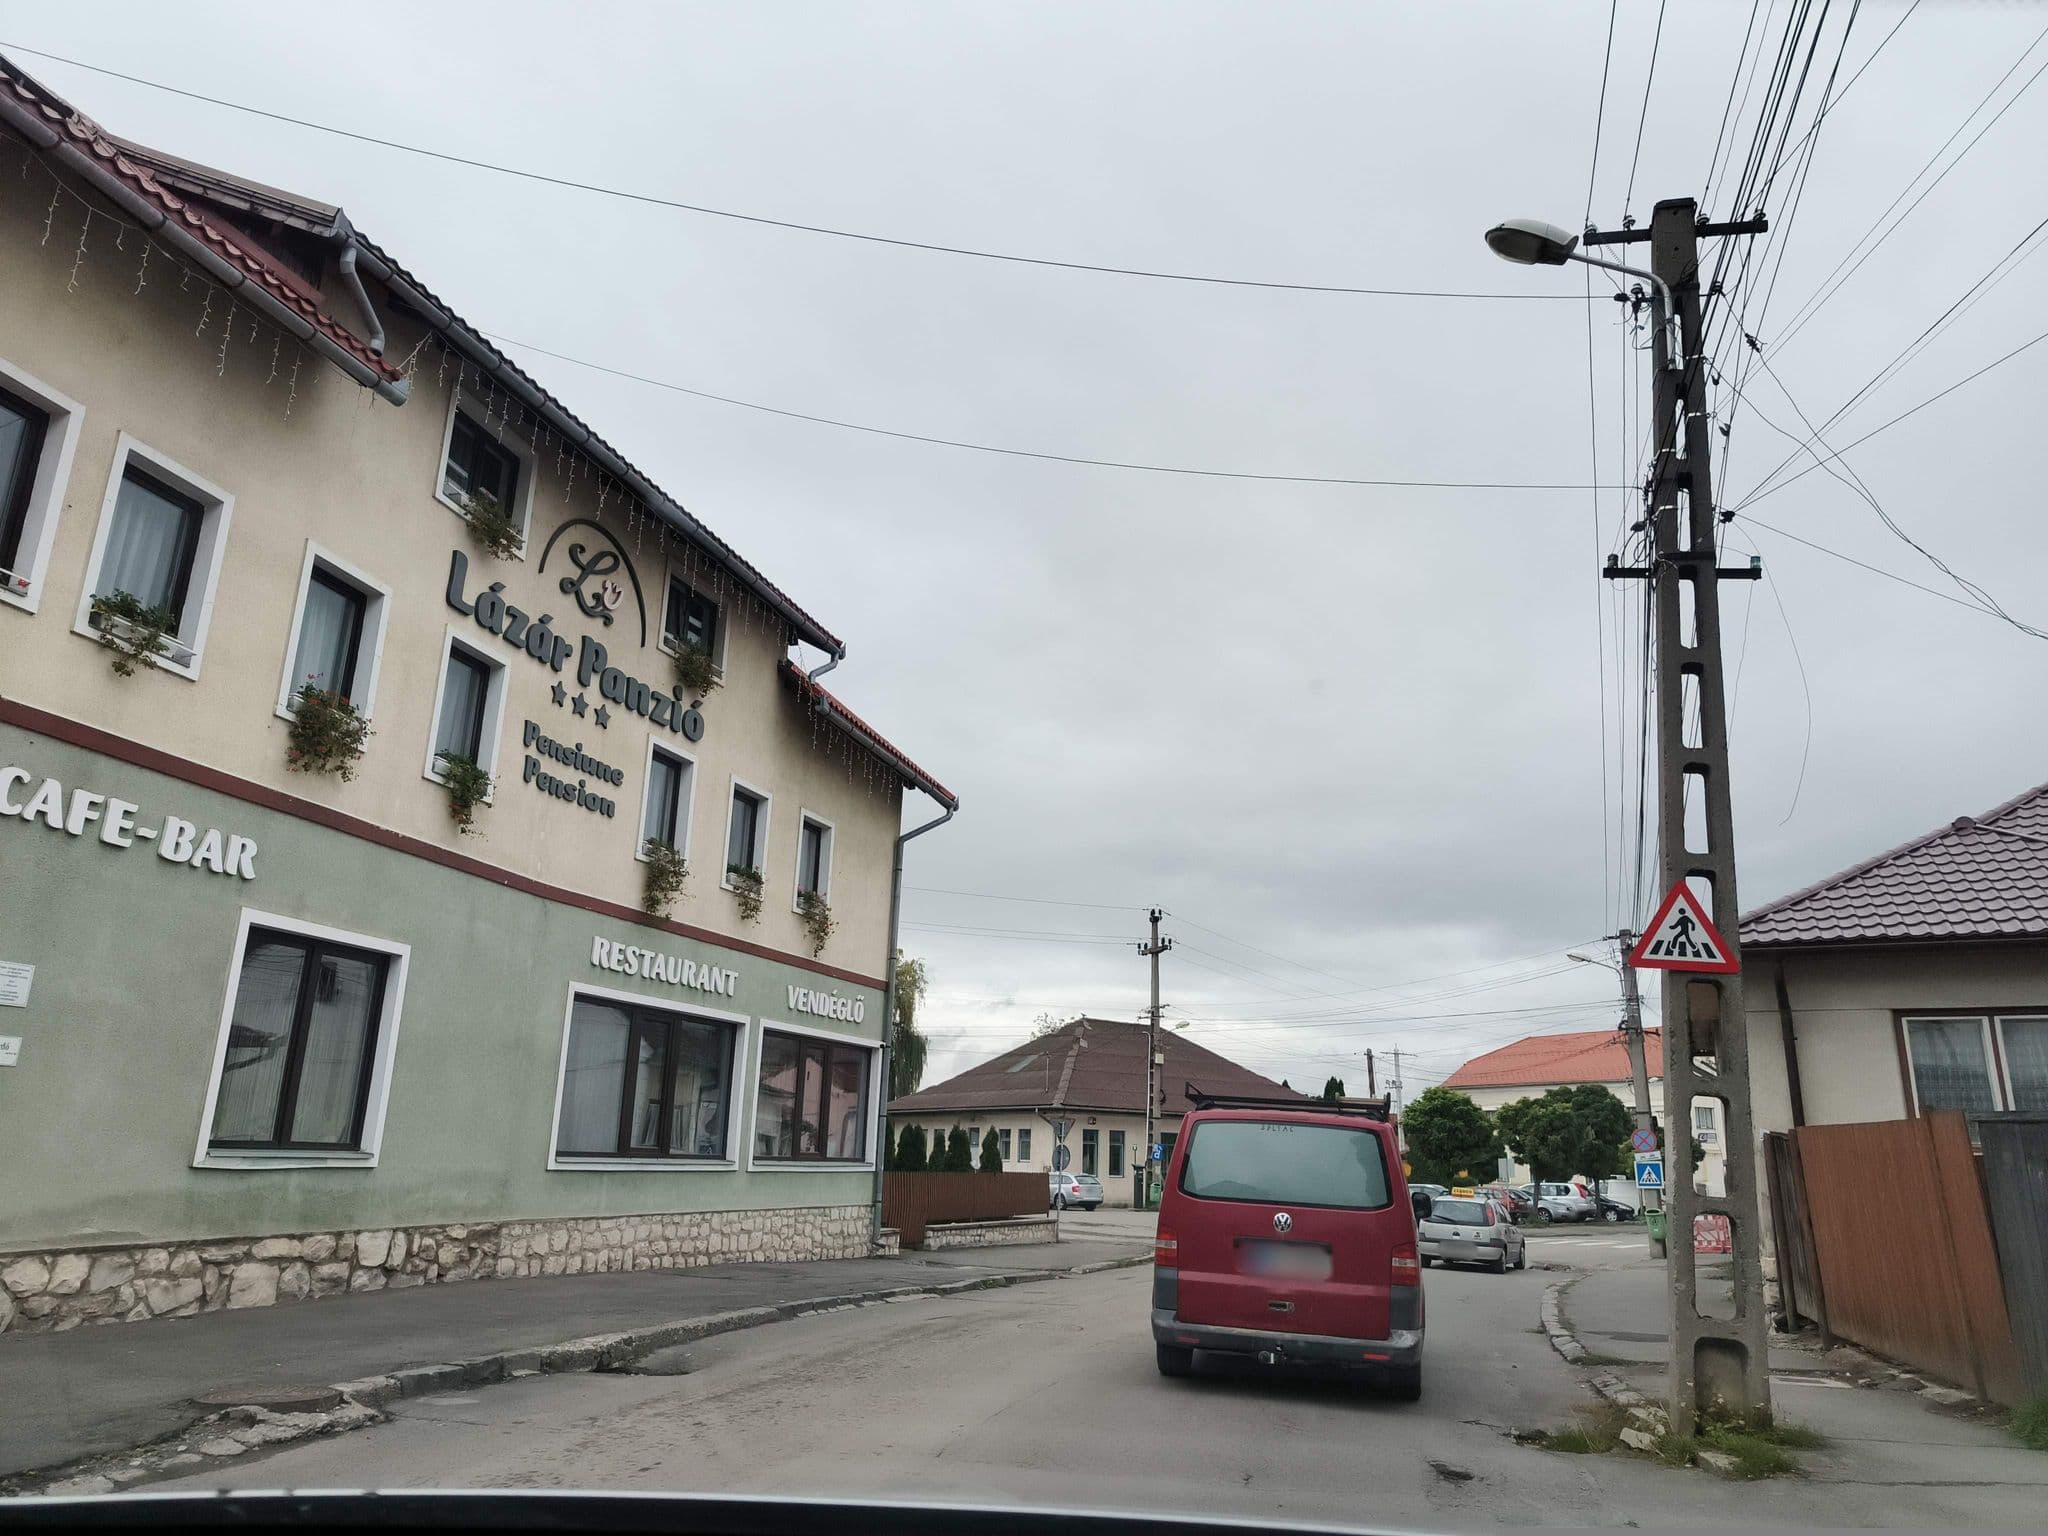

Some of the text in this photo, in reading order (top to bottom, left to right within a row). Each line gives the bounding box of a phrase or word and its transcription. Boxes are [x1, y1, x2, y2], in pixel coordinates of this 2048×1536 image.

[445, 549, 705, 743] Lázár Panzió
[523, 719, 625, 787] Pensiune
[523, 754, 616, 818] Pension
[0, 766, 259, 880] CAFE-BAR
[590, 935, 739, 997] RESTAURANT
[787, 984, 866, 1024] VENDÉGLŐ
